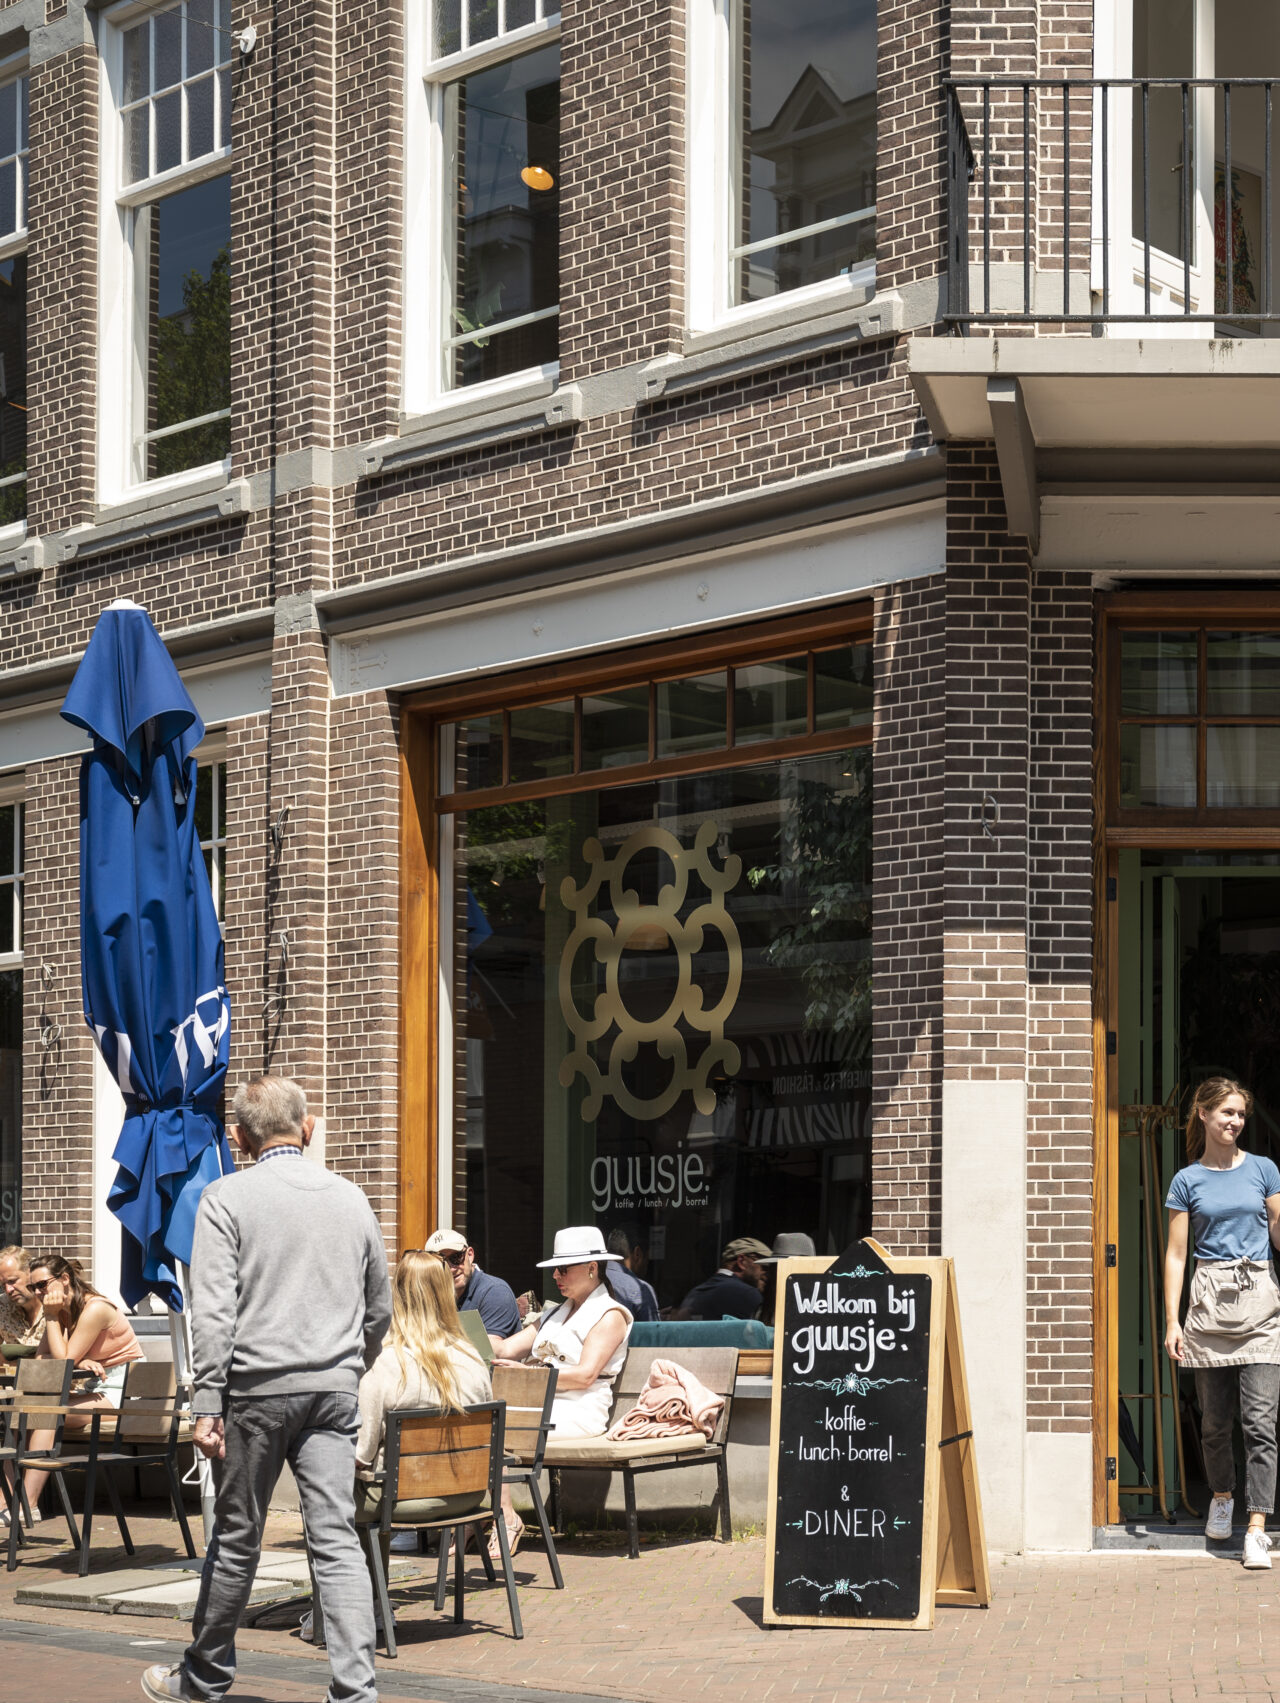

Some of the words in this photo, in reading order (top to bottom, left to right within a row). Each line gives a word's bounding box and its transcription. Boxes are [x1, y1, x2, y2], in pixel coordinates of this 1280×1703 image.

[615, 1198, 634, 1208] koffie
[638, 1199, 642, 1208] /
[644, 1197, 662, 1207] lunch
[665, 1198, 669, 1208] /
[685, 1195, 708, 1206] borrel
[793, 1281, 877, 1314] Welkom
[888, 1285, 916, 1331] bij
[825, 1405, 866, 1432] koffie
[841, 1486, 850, 1501] &
[805, 1509, 886, 1538] DINER
